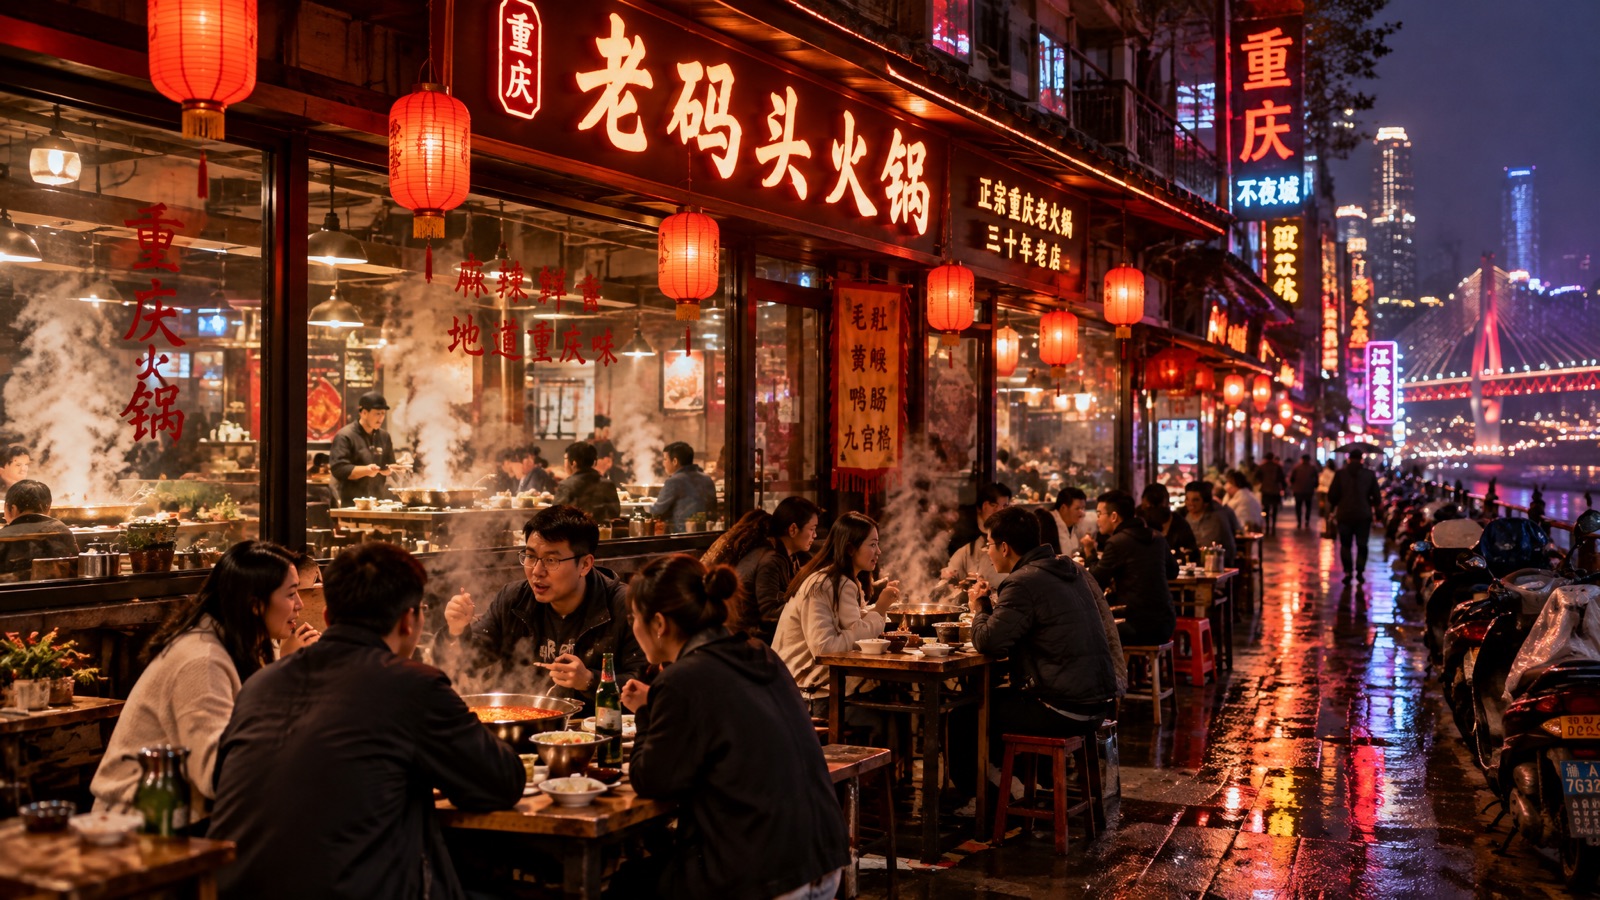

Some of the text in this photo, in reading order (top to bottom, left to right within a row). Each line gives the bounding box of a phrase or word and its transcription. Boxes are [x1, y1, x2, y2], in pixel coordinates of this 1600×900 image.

[506, 12, 535, 104] 重庆
[1239, 27, 1294, 163] 重庆
[575, 12, 930, 236] 老码头火锅
[1237, 175, 1300, 207] 不夜城
[986, 224, 1061, 271] 三十年老店
[120, 202, 186, 443] 重庆火锅
[447, 314, 618, 367] 地道重庆味
